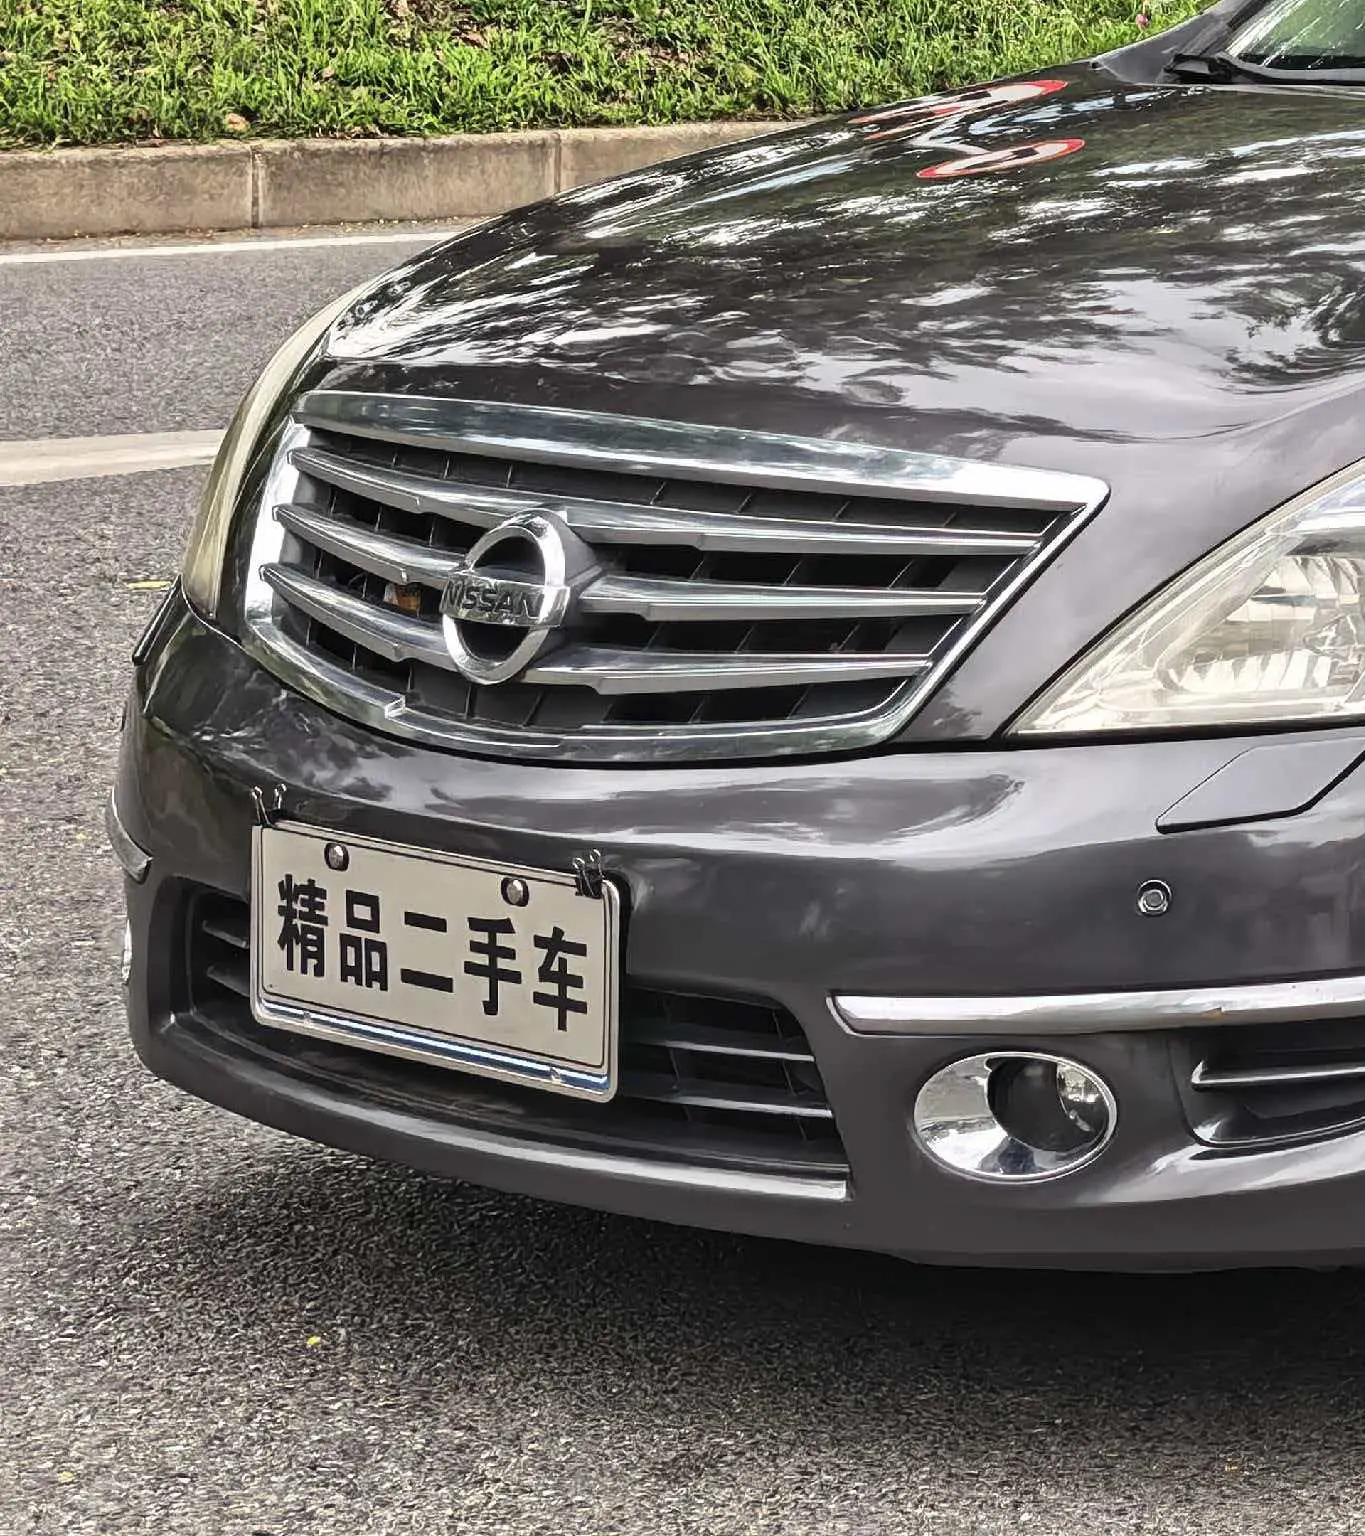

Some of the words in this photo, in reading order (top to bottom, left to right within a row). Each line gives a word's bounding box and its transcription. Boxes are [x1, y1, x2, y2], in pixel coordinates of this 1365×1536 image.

[443, 576, 548, 621] NISSAN
[277, 873, 588, 1032] 精品二手车
